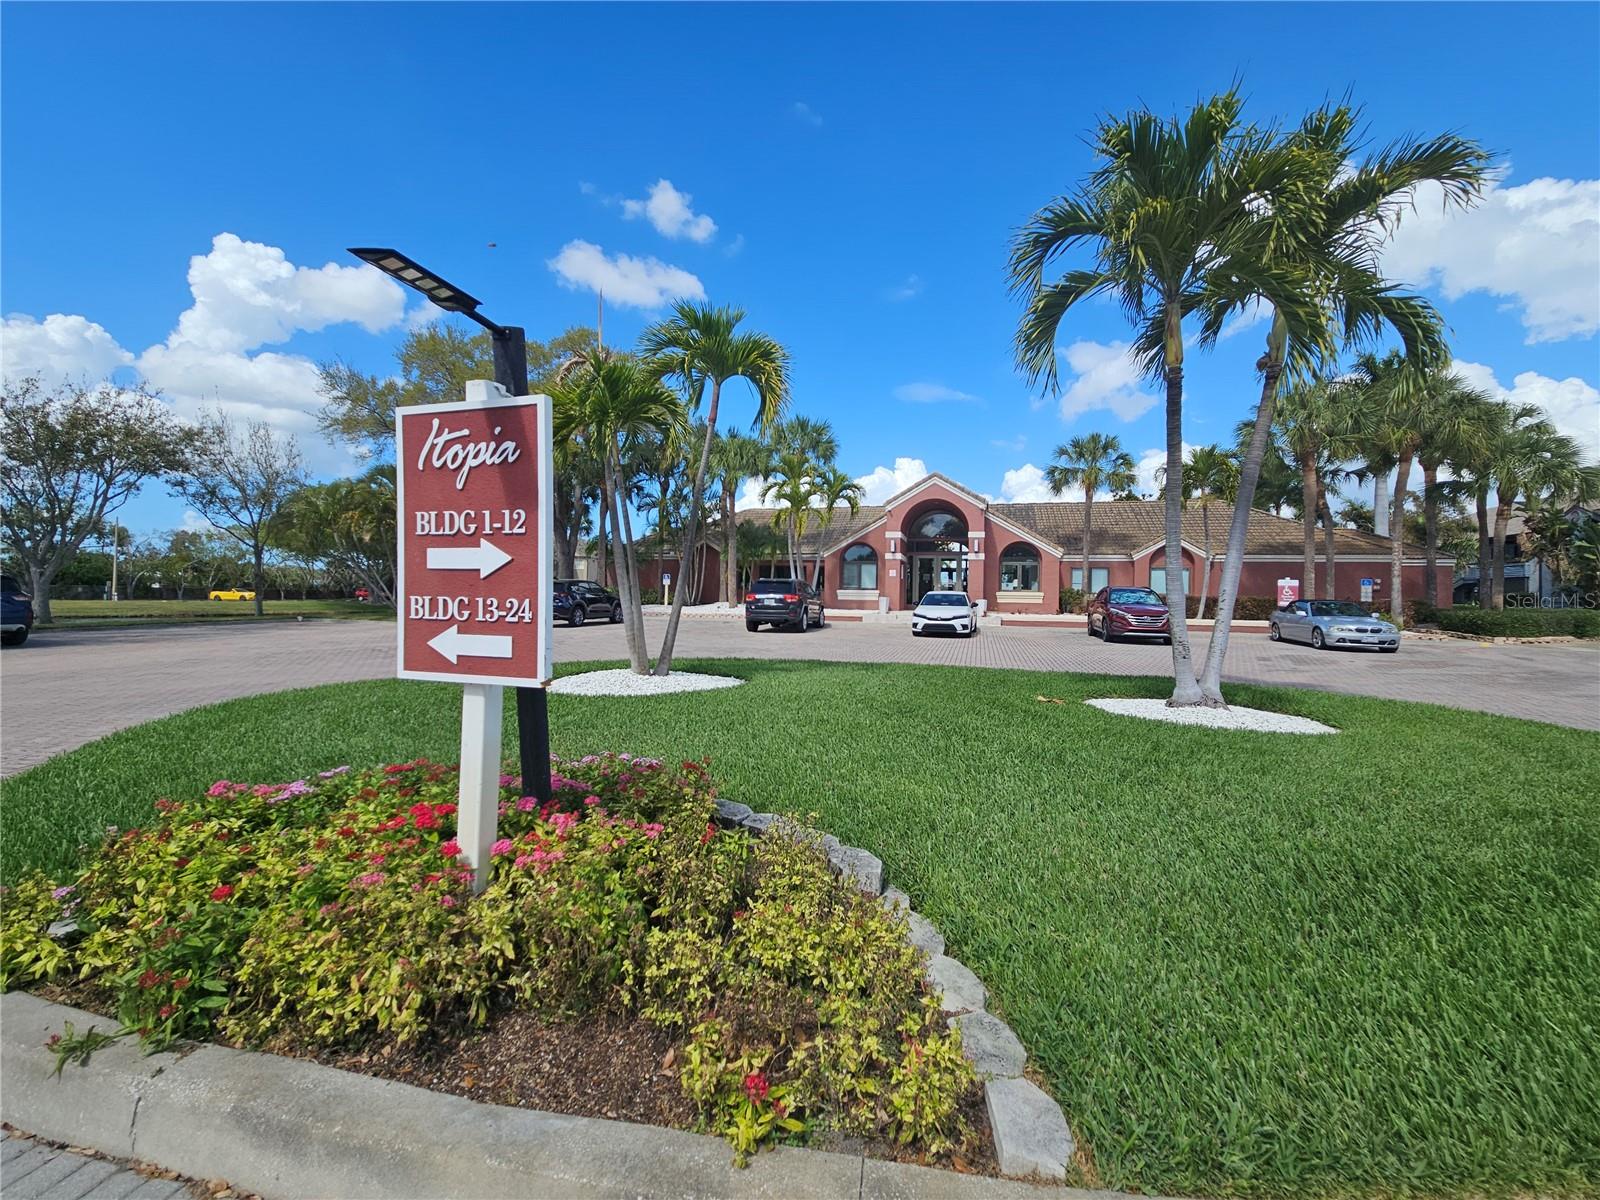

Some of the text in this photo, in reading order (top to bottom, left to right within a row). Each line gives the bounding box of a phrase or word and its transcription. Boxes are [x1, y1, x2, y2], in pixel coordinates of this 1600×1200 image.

[418, 418, 520, 490] Itopia
[415, 509, 526, 535] BLDG 1-12
[409, 595, 533, 623] BLDG 13-24
